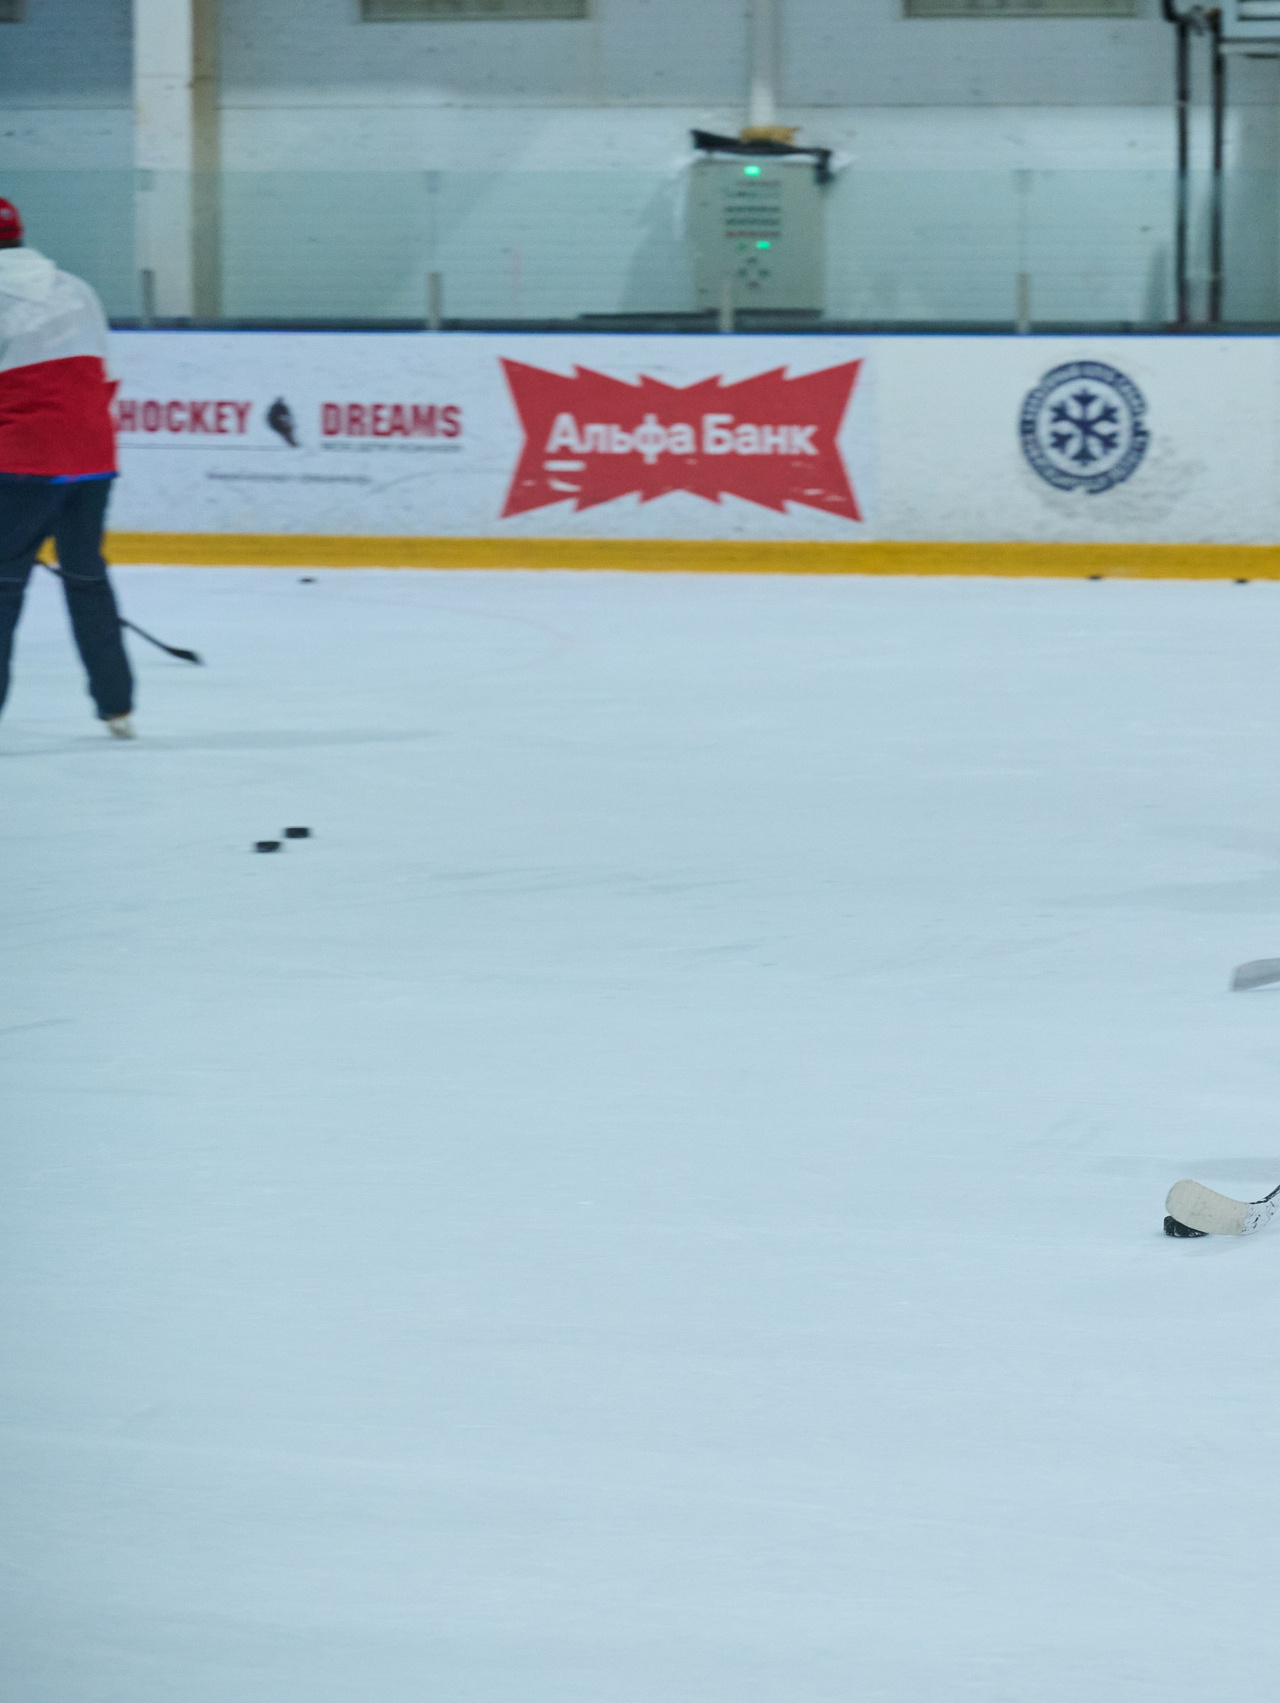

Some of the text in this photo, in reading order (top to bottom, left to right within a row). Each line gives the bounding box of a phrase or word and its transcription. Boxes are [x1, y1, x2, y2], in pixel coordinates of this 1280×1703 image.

[118, 399, 464, 438] HOCKEY DREAMS
[545, 412, 819, 465] Альфа Банк
